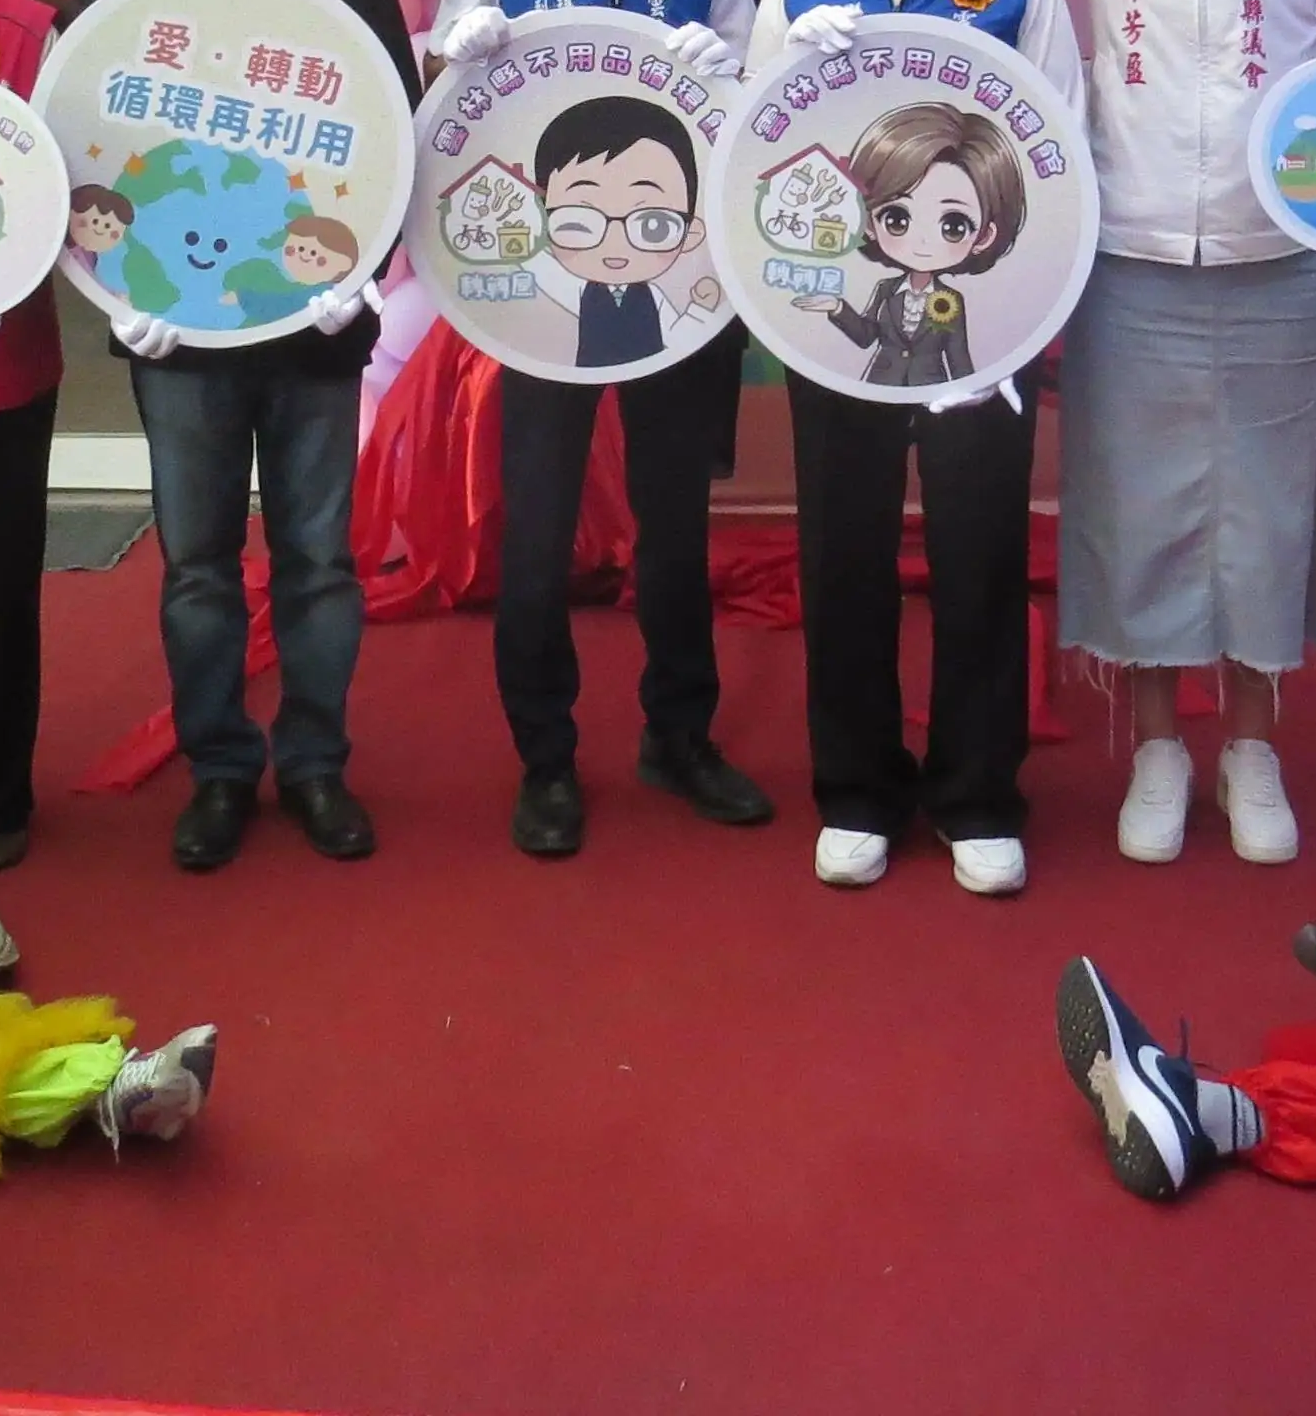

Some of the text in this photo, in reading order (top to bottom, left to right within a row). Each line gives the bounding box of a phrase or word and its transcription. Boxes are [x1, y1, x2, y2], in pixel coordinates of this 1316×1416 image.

[105, 70, 356, 167] 循環再利用
[750, 46, 1067, 180] 雲林縣不用品循環館
[458, 271, 538, 301] 轉轉屋
[763, 258, 845, 297] 轉轉屋
